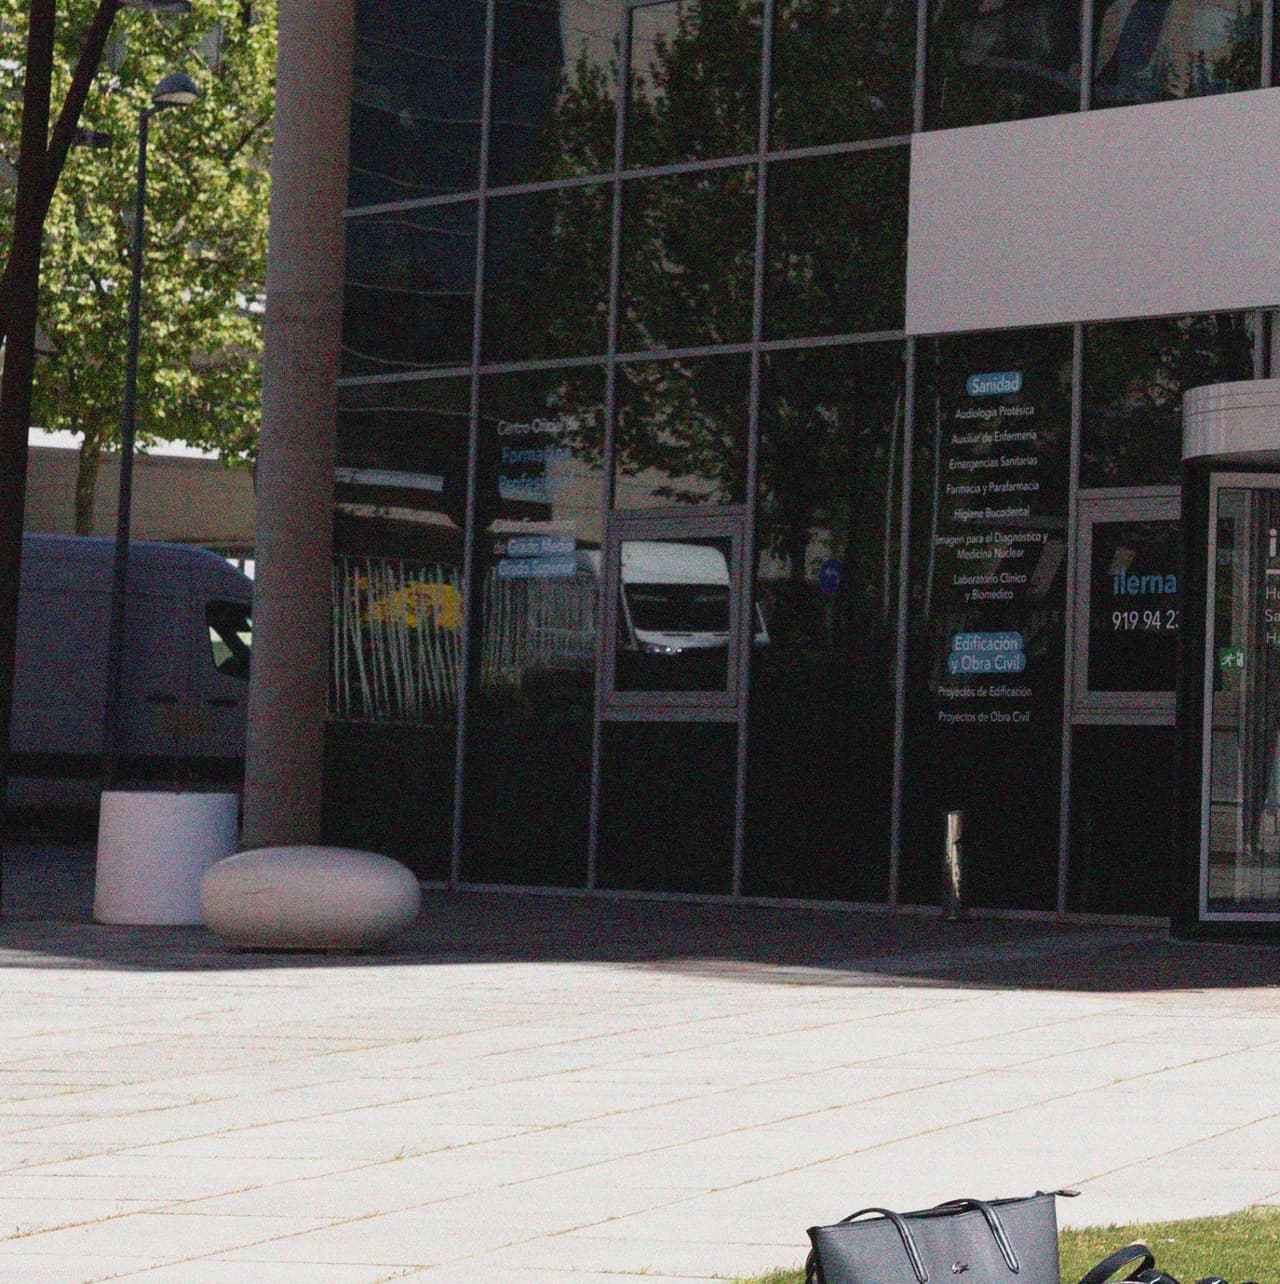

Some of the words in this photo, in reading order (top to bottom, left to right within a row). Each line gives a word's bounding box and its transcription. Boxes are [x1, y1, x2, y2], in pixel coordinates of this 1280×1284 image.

[972, 374, 1019, 393] Sanidad
[952, 434, 980, 444] Auxiliar
[982, 434, 992, 442] de
[949, 459, 998, 471] Emergencias
[1000, 456, 1037, 468] Sanitarias
[946, 484, 980, 495] Farmacia
[983, 485, 987, 495] y
[989, 481, 1039, 492] Parafarmacia
[954, 509, 983, 521] Higiene
[986, 506, 1030, 518] Bucodental
[936, 534, 964, 545] Imagen
[967, 535, 984, 545] para
[986, 533, 992, 543] el
[1043, 534, 1048, 543] y
[957, 550, 991, 560] Medicina
[994, 548, 1024, 558] Nuclear
[953, 575, 998, 585] Laboratorio
[1113, 568, 1177, 595] ilerna
[965, 593, 970, 601] y
[1112, 610, 1138, 630] 919
[1144, 610, 1161, 629] 94
[955, 636, 1018, 651] Edificación
[951, 660, 958, 673] y
[961, 656, 991, 669] Obra
[995, 655, 1020, 669] Civil
[938, 686, 975, 699] Proyectos
[977, 686, 987, 696] de
[939, 712, 976, 723] Proyectos
[978, 712, 989, 722] de
[991, 712, 1010, 722] Obra
[1013, 711, 1030, 722] Civil
